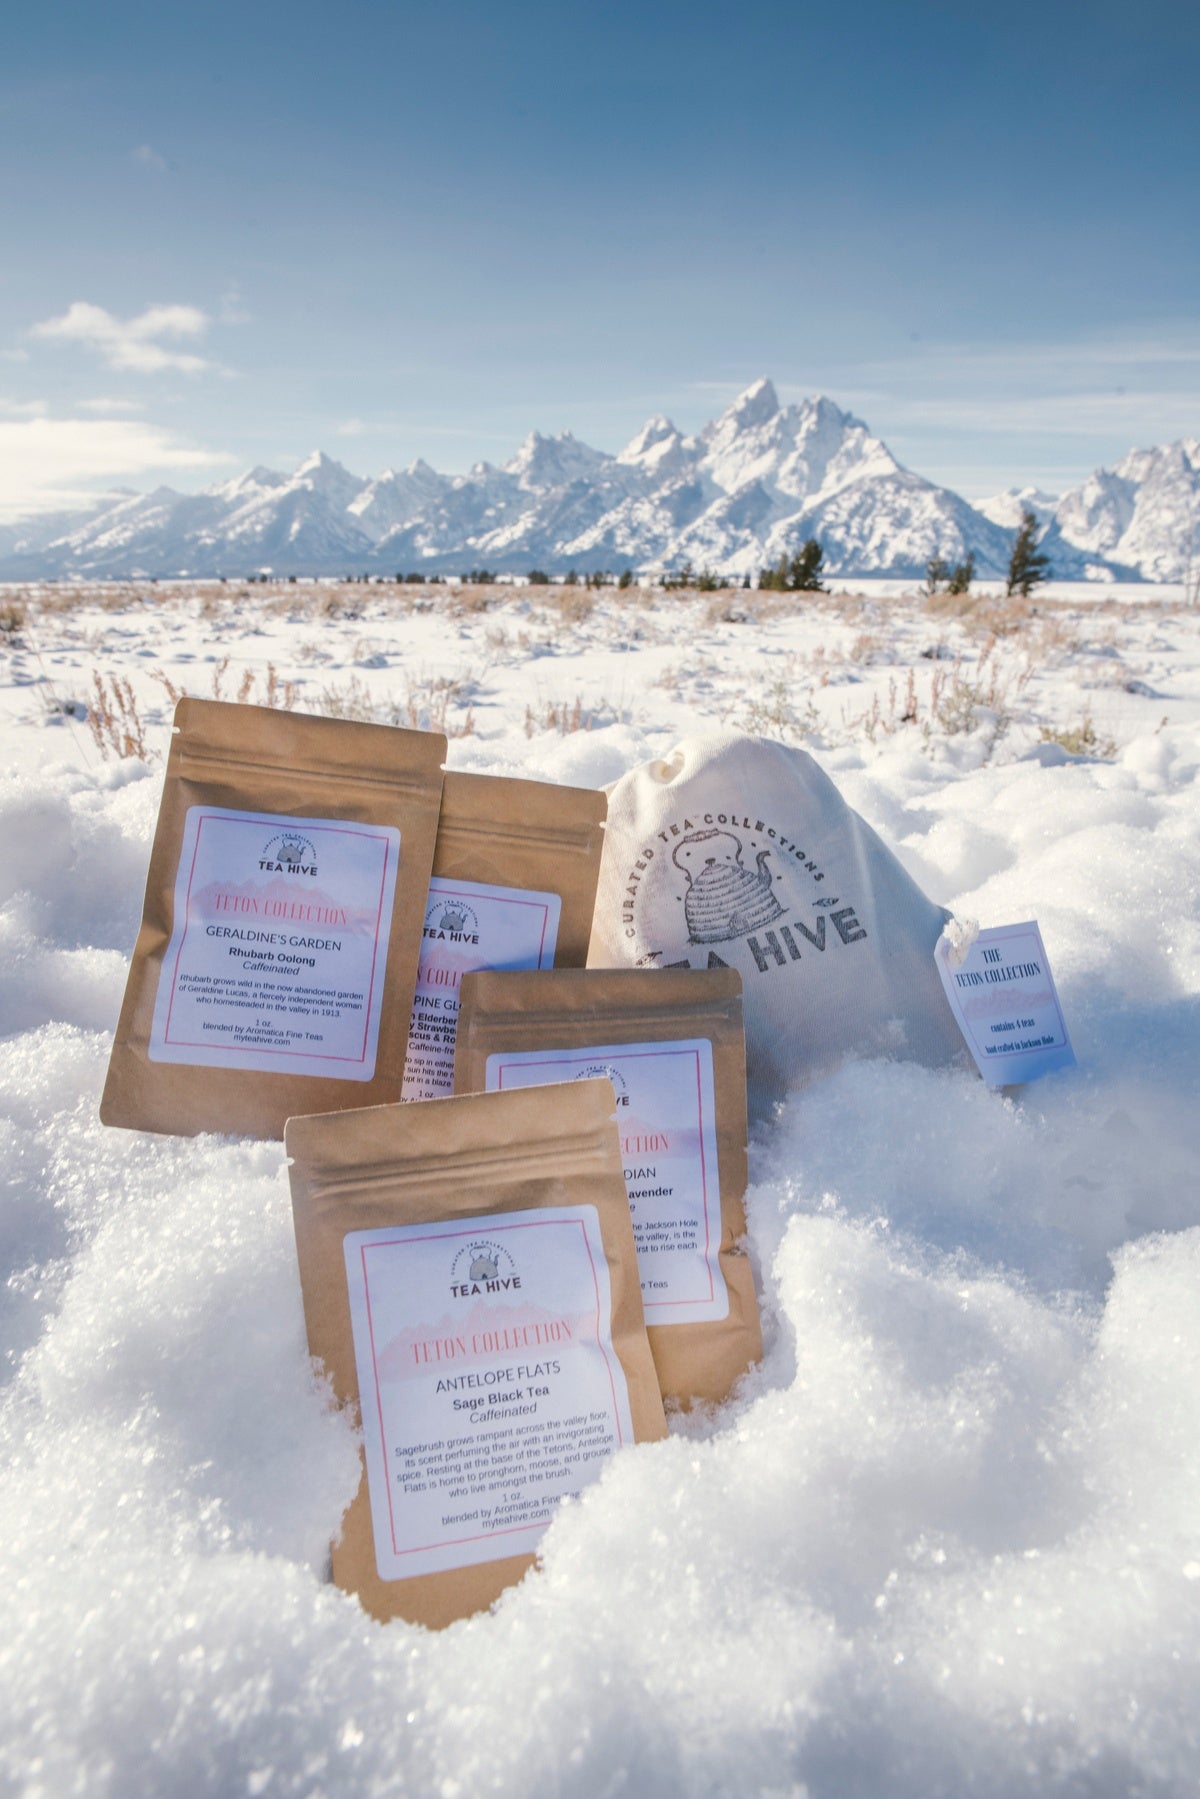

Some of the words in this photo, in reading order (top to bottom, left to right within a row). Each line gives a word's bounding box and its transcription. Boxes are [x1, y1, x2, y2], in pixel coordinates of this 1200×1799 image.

[259, 861, 284, 872] TEA
[287, 865, 318, 876] HIVE
[622, 849, 654, 938] CURATED
[658, 819, 694, 844] TEA
[704, 814, 826, 882] COLLECTIONS
[216, 893, 258, 914] TETON
[264, 899, 346, 926] COLLECTION
[206, 925, 288, 946] GERALDINE'S
[289, 936, 342, 952] GARDEN
[423, 928, 446, 940] TEA
[450, 933, 480, 944] HIVE
[747, 907, 868, 974] HIVE
[229, 947, 274, 962] Rhubarb
[277, 953, 316, 968] Oolong
[981, 948, 1002, 964] THE
[242, 960, 300, 976] Caffeinated
[426, 967, 464, 988] COLL
[955, 972, 984, 988] TETON
[984, 962, 1042, 984] COLLECTION
[180, 974, 212, 984] Rhubarb
[213, 977, 236, 986] grows
[238, 980, 252, 988] wild
[255, 982, 262, 990] in
[277, 984, 292, 992] now
[294, 986, 336, 998] abandoned
[338, 990, 364, 1002] garden
[188, 985, 224, 994] Geraldine
[225, 988, 250, 998] Lucas,
[260, 991, 286, 1002] fiercely
[288, 995, 334, 1008] independent
[335, 1002, 362, 1010] woman
[213, 998, 264, 1010] homesteaded
[275, 1004, 288, 1012] the
[289, 1006, 310, 1016] valley
[312, 1008, 320, 1016] in
[321, 1009, 342, 1018] 1913.
[414, 995, 442, 1009] PINE
[444, 999, 462, 1012] GL
[417, 1022, 456, 1034] Strawbe
[418, 1013, 458, 1026] Elderber
[990, 1021, 1016, 1032] contains
[1021, 1018, 1036, 1028] teas
[203, 1022, 234, 1032] blended
[235, 1025, 244, 1034] by
[246, 1027, 284, 1037] Aromatica
[286, 1030, 302, 1039] Fine
[305, 1032, 324, 1041] Teas
[234, 1034, 290, 1046] myteahive.com
[409, 1031, 430, 1041] scus
[434, 1034, 440, 1042] &
[443, 1034, 456, 1044] Ro
[409, 1042, 454, 1055] Caffeine-fre
[985, 1044, 998, 1054] hand
[997, 1042, 1014, 1052] crafted
[1014, 1041, 1021, 1050] in
[1020, 1039, 1042, 1051] Jackson
[414, 1058, 424, 1066] sip
[426, 1058, 433, 1066] in
[422, 1068, 435, 1076] hits
[404, 1076, 416, 1084] upt
[432, 1079, 452, 1088] blaze
[622, 1134, 669, 1154] CTION
[624, 1168, 656, 1180] DIAN
[628, 1186, 674, 1200] avender
[632, 1223, 642, 1231] he
[644, 1221, 678, 1230] Jackson
[680, 1220, 698, 1228] Hole
[634, 1234, 644, 1242] he
[646, 1232, 672, 1242] valley,
[673, 1231, 681, 1239] is
[636, 1246, 649, 1254] irst
[660, 1243, 676, 1252] rise
[677, 1241, 698, 1250] each
[450, 1283, 482, 1298] TEA
[486, 1277, 522, 1294] HIVE
[648, 1280, 669, 1289] Teas
[411, 1337, 466, 1364] TETON
[472, 1320, 572, 1355] COLLECTION
[436, 1368, 514, 1394] ANTELOPE
[517, 1360, 561, 1380] FLATS
[453, 1398, 485, 1411] Sage
[488, 1389, 524, 1404] Black
[527, 1386, 550, 1398] Tea
[470, 1402, 538, 1424] Caffeinated
[395, 1440, 444, 1457] Sagebrush
[447, 1435, 474, 1449] grows
[476, 1429, 513, 1442] rampant
[516, 1425, 545, 1435] across
[547, 1421, 561, 1430] the
[563, 1415, 588, 1426] valley
[405, 1459, 416, 1468] its
[418, 1454, 442, 1466] scent
[445, 1445, 490, 1462] perfuming
[492, 1442, 507, 1452] the
[509, 1440, 520, 1450] air
[523, 1435, 541, 1446] with
[543, 1434, 554, 1443] an
[556, 1424, 605, 1440] invigorating
[397, 1470, 424, 1482] spice.
[426, 1464, 462, 1478] Resting
[464, 1461, 472, 1470] at
[475, 1458, 490, 1468] the
[491, 1454, 514, 1466] base
[516, 1451, 525, 1460] of
[526, 1448, 541, 1458] the
[578, 1434, 614, 1449] Antelope
[404, 1483, 427, 1494] Flats
[429, 1481, 438, 1490] is
[440, 1476, 465, 1487] home
[467, 1473, 476, 1482] to
[478, 1464, 528, 1481] pronghorn,
[529, 1458, 562, 1470] moose,
[564, 1453, 580, 1464] and
[583, 1447, 612, 1462] grouse
[449, 1488, 469, 1498] who
[470, 1484, 486, 1494] live
[488, 1476, 528, 1491] amongst
[529, 1474, 544, 1483] the
[545, 1467, 573, 1480] brush.
[502, 1493, 508, 1502] 1
[511, 1492, 524, 1500] oz.
[442, 1510, 479, 1526] blended
[481, 1508, 492, 1518] by
[494, 1500, 540, 1515] Aromatica
[541, 1494, 561, 1506] Fine
[482, 1508, 550, 1528] myteahive.com
